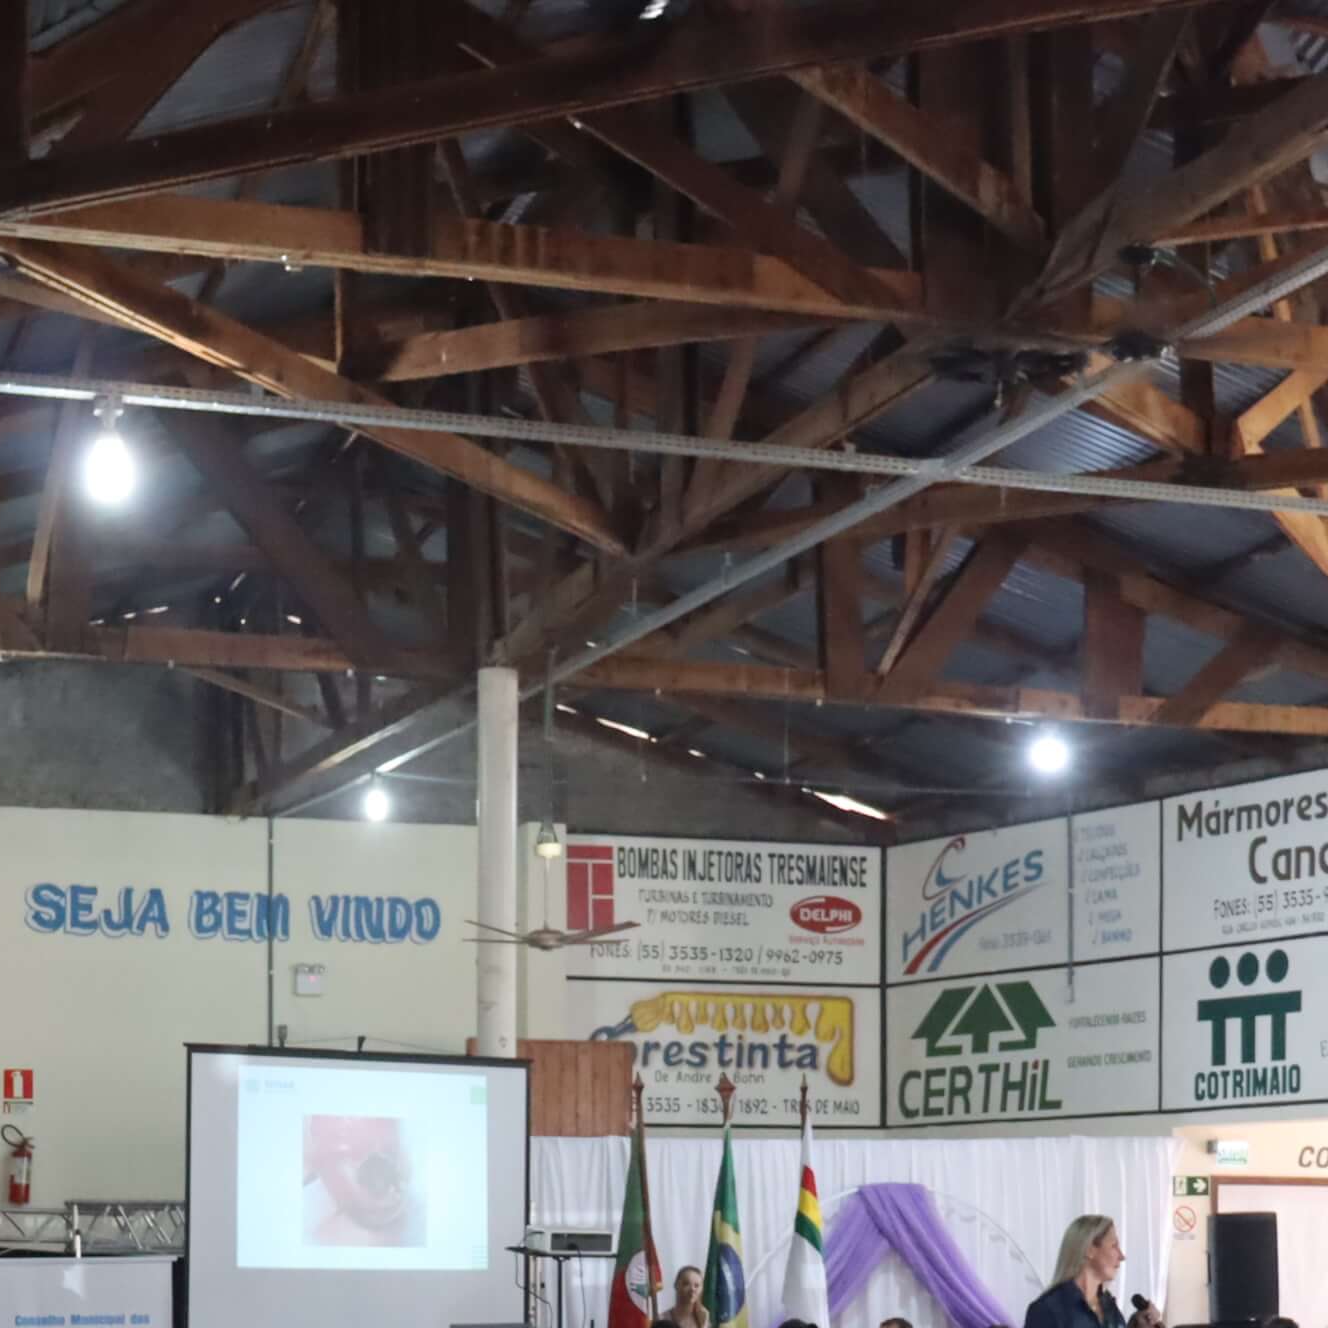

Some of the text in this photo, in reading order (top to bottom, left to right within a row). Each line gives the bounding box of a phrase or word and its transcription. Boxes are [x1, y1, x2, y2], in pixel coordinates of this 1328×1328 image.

[617, 846, 869, 889] BOMBAS INJETORAS TRESMAIENSE
[25, 883, 442, 944] SEJA BEM VINDO
[798, 905, 854, 923] DELPHI
[902, 849, 1044, 963] HENKES
[669, 943, 754, 964] 3535-1320
[765, 947, 844, 967] 9962-0975
[627, 1034, 819, 1072] restinta
[1194, 1063, 1302, 1102] COTRIMAIO
[646, 1096, 682, 1115] 3535
[832, 1101, 861, 1118] MAIO
